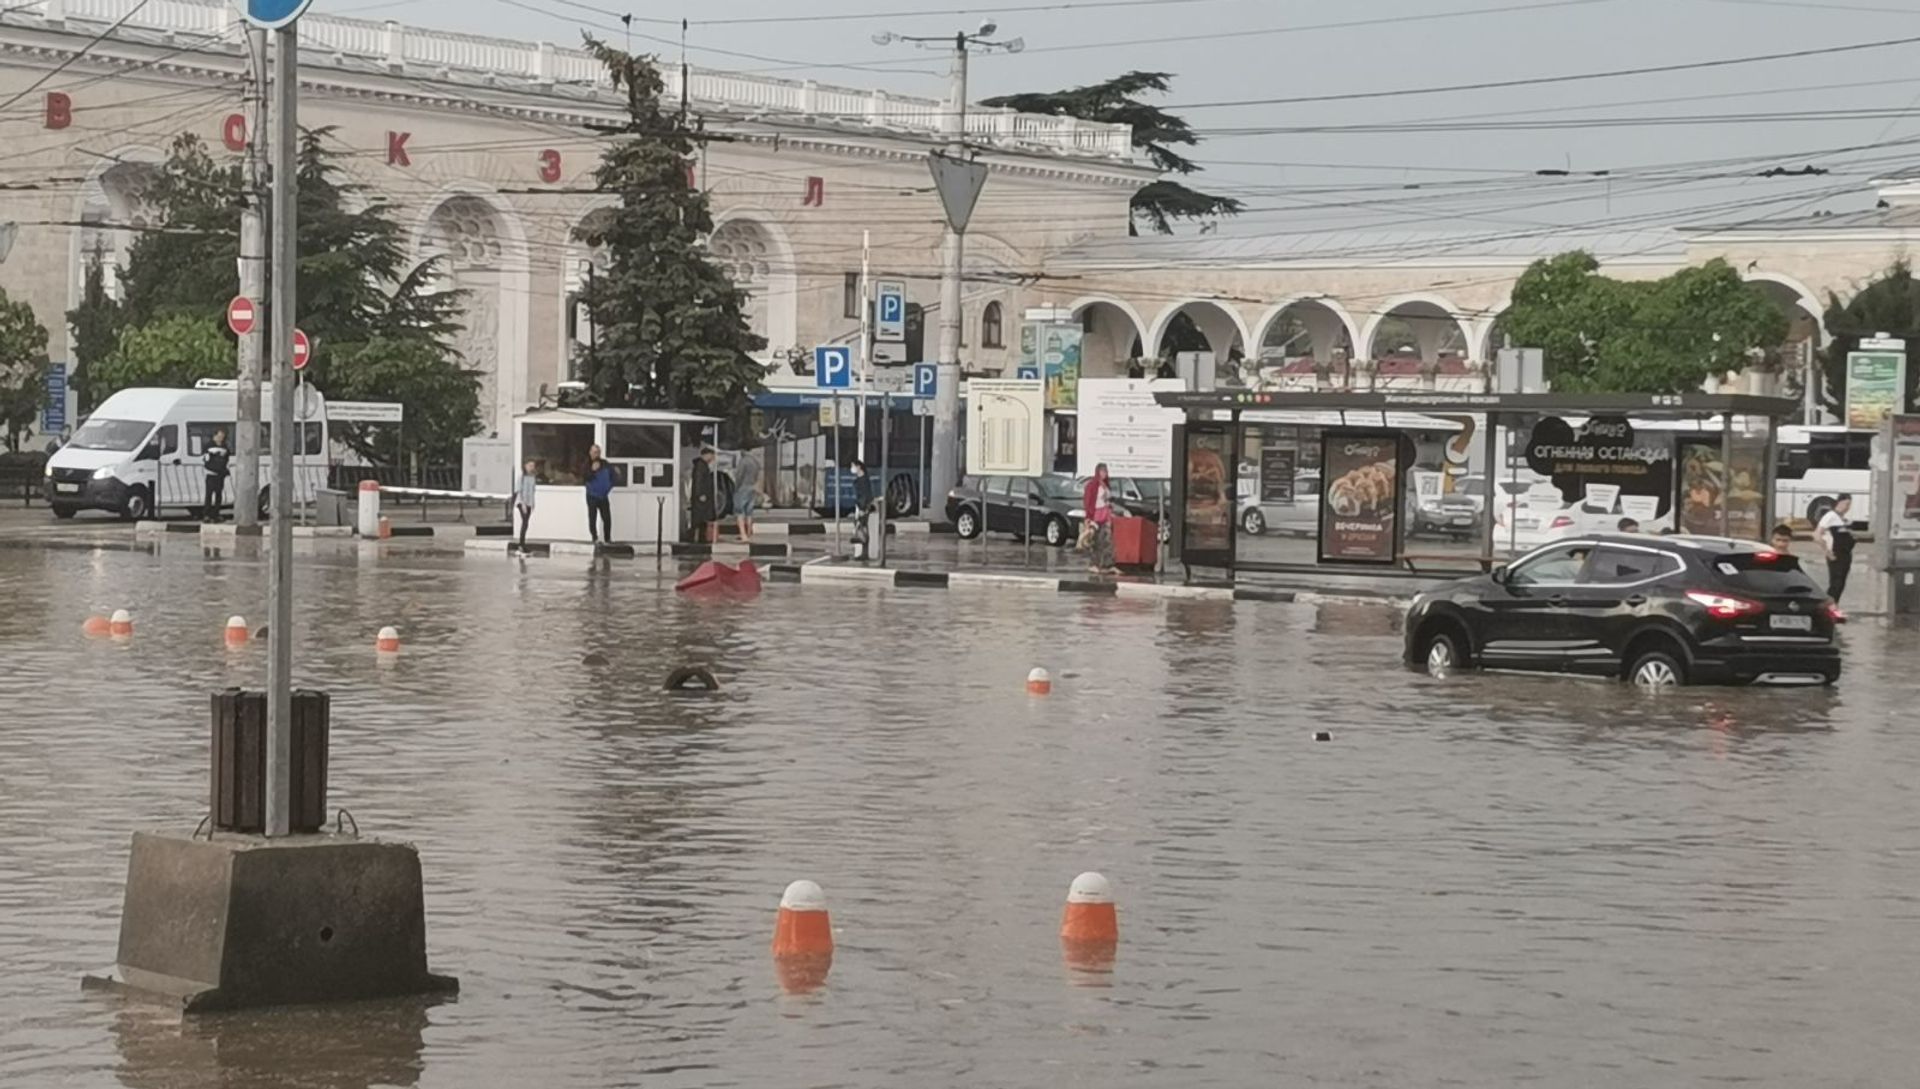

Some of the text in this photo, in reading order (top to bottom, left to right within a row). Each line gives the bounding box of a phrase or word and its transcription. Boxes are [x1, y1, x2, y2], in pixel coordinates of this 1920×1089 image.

[885, 296, 898, 320] P
[824, 350, 845, 385] P
[919, 367, 934, 393] P
[1534, 445, 1669, 462] ОГНЕННАЯ ОСТАНОВКА
